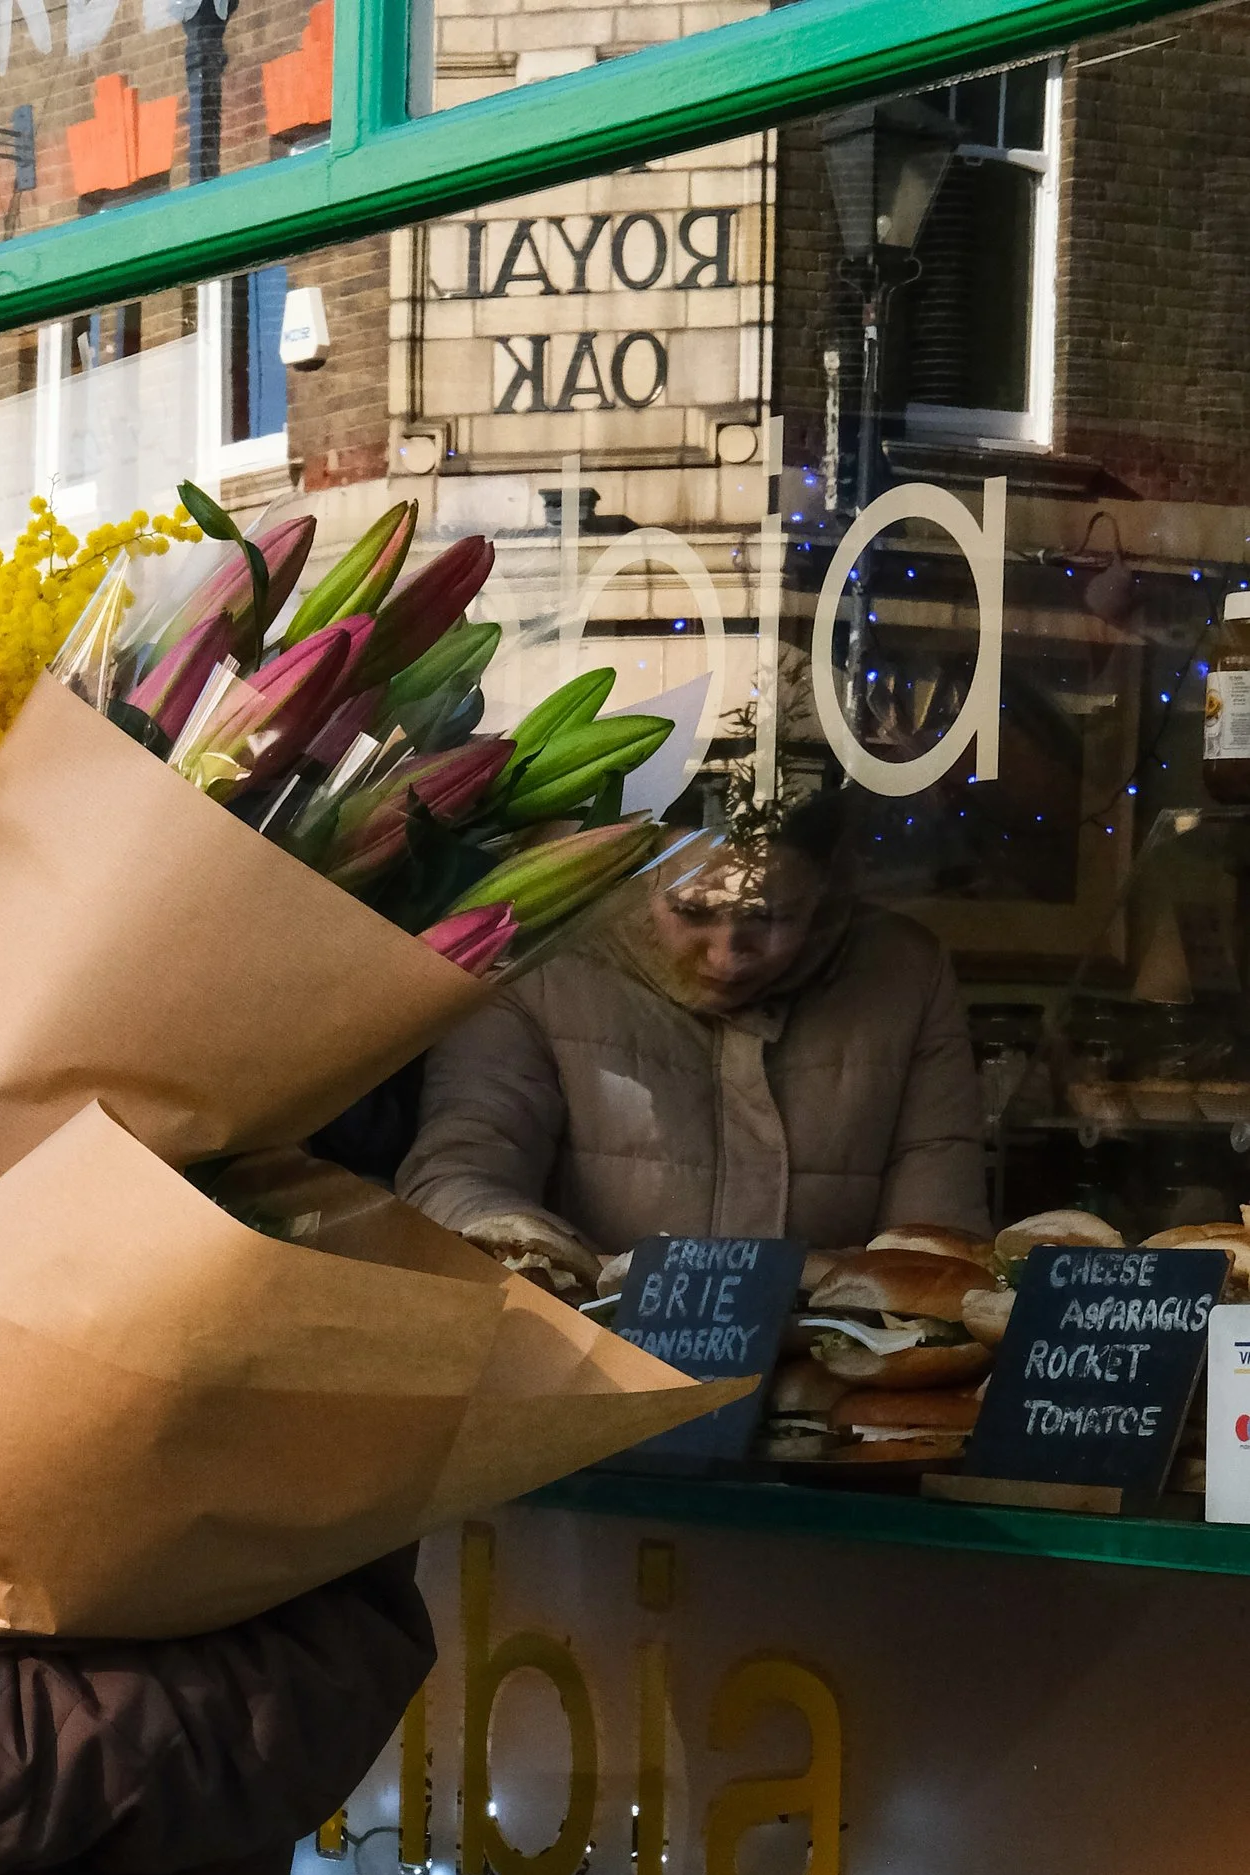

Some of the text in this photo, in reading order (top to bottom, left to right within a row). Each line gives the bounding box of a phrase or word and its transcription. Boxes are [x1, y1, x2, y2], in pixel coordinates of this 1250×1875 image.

[664, 1238, 760, 1271] FRENCH
[1050, 1252, 1159, 1289] CHEESE
[638, 1271, 743, 1323] BRIE
[1059, 1293, 1213, 1333] ASPARAGUS
[1024, 1339, 1151, 1383] ROCKET
